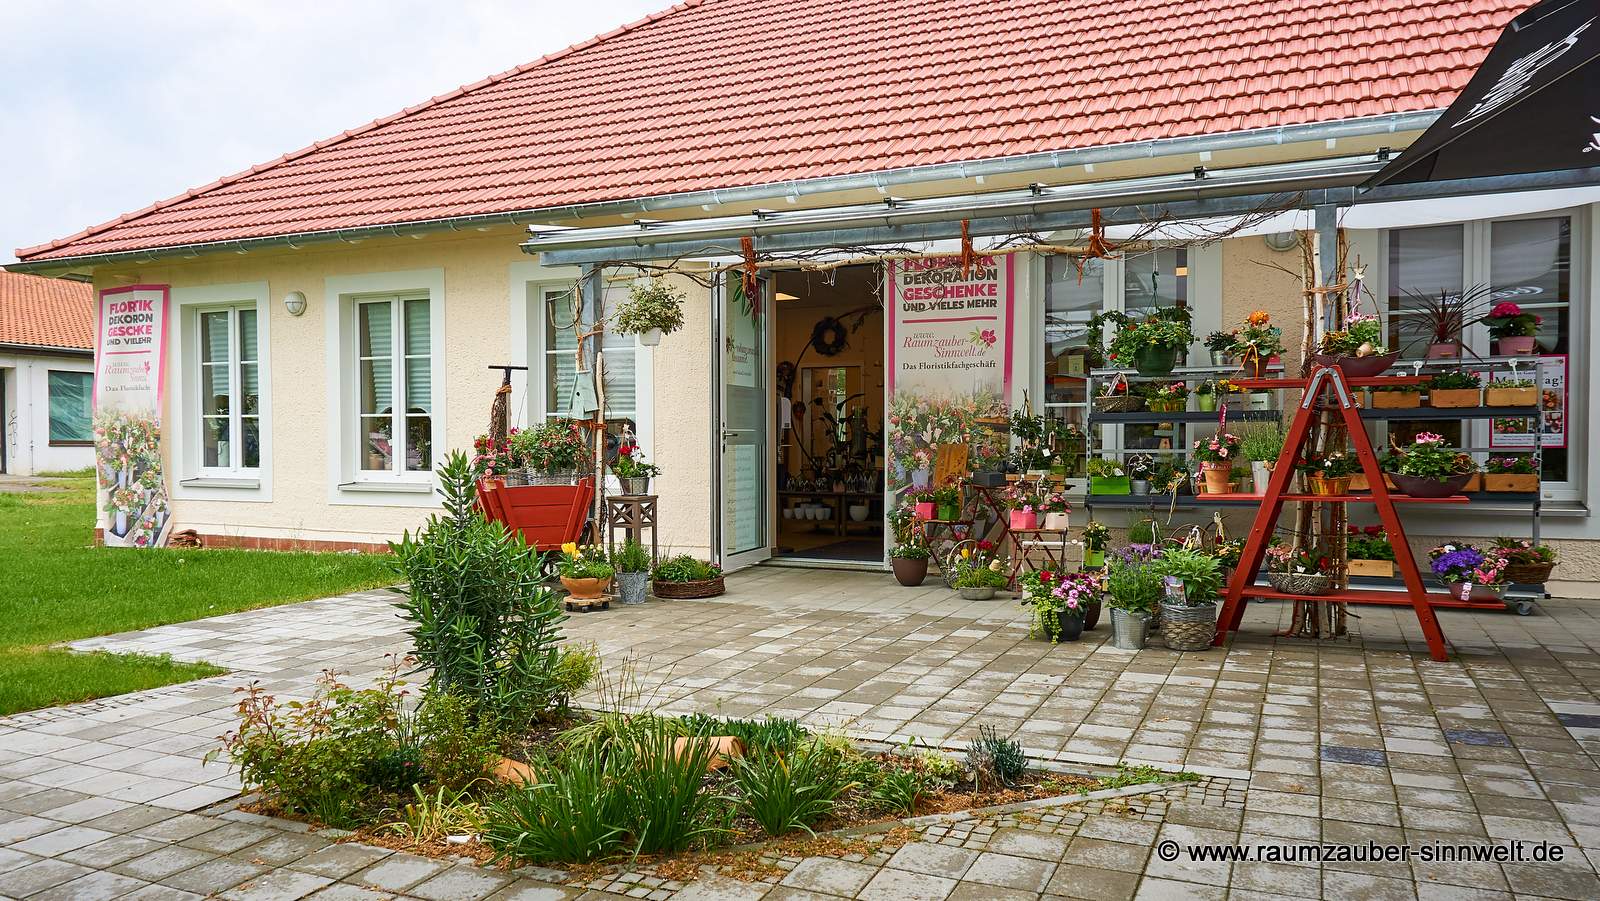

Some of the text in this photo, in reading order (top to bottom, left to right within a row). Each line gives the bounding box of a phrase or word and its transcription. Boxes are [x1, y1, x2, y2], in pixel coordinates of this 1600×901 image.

[903, 283, 997, 301] GESCHENKE
[902, 299, 998, 312] UND VIELES MEHR
[919, 360, 996, 371] Floristikfachgeschäft
